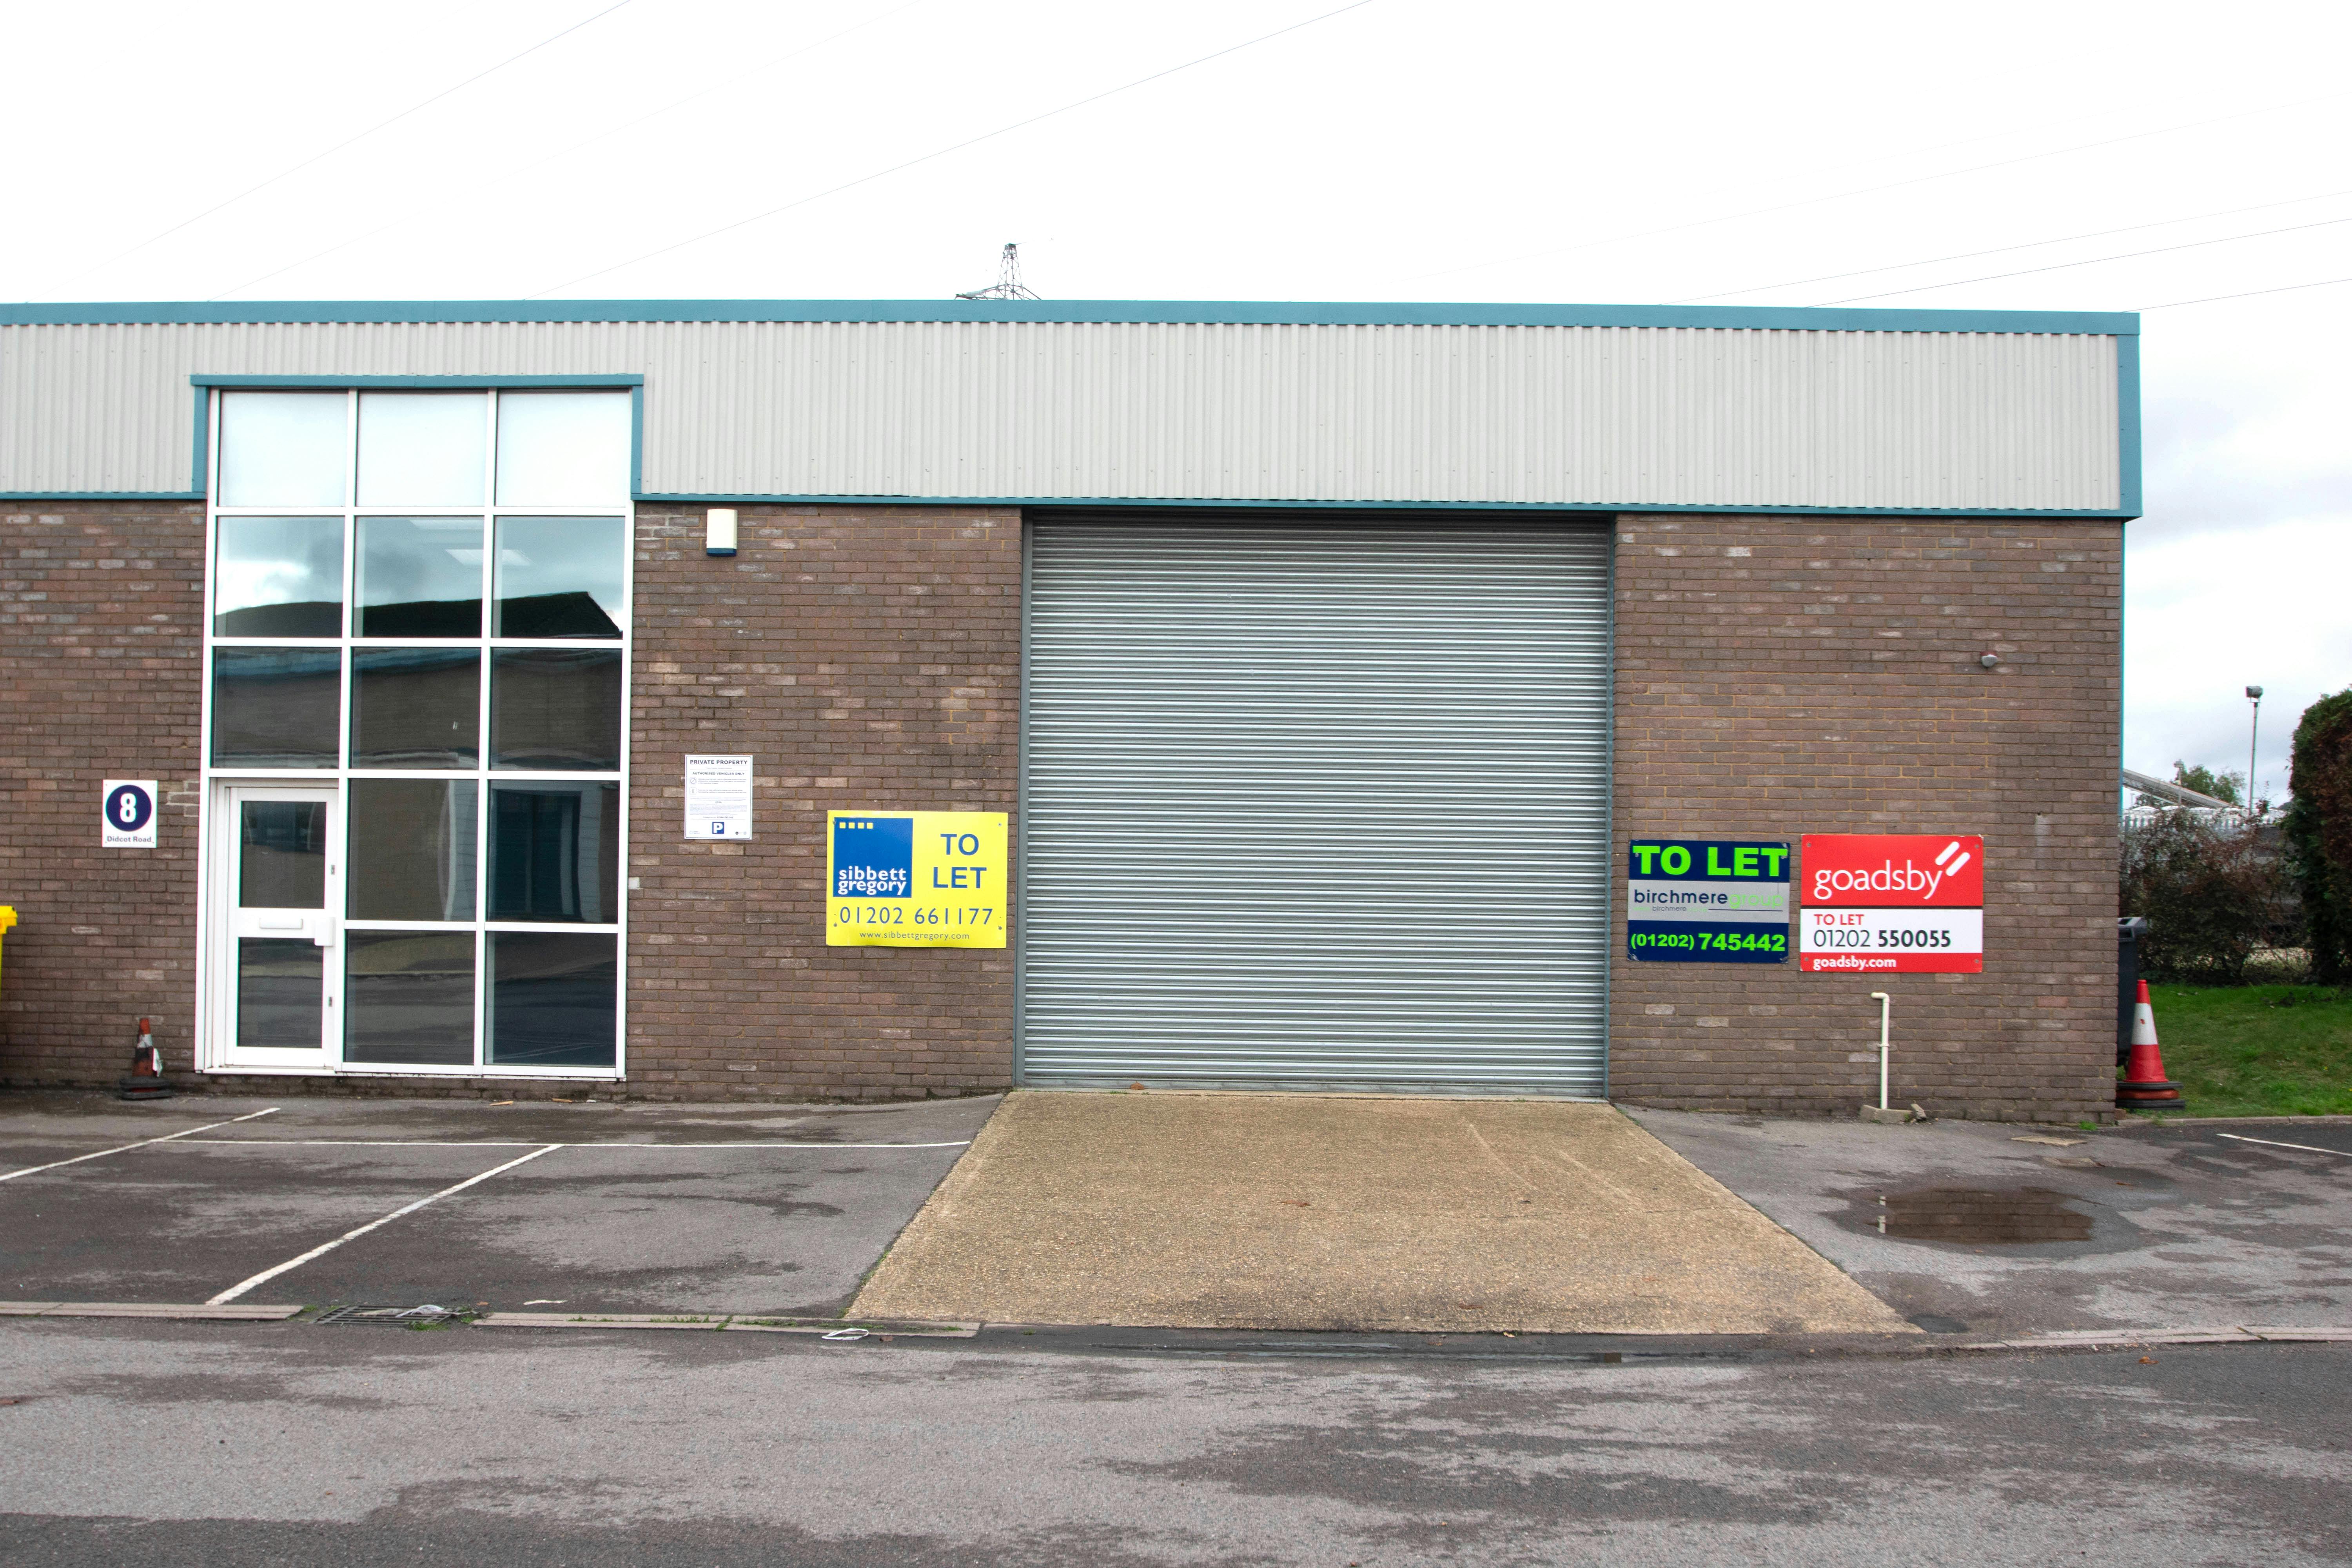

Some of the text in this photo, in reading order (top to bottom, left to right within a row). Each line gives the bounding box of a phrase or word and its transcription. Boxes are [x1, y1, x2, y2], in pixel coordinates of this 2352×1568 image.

[120, 793, 136, 822] 8
[940, 834, 979, 855] TO
[1633, 845, 1788, 877] TO LET
[839, 866, 906, 880] sibbett
[933, 867, 987, 888] LET
[1813, 860, 1942, 900] goadsby
[838, 881, 907, 896] gregory
[840, 907, 993, 925] 01202 661177
[1814, 914, 1864, 926] TO LET
[860, 931, 969, 941] www.sibbettgregory.com
[1631, 933, 1785, 951] (01202) 745442
[1814, 929, 1951, 947] 01202 550055
[1813, 955, 1896, 971] goadsby.com
